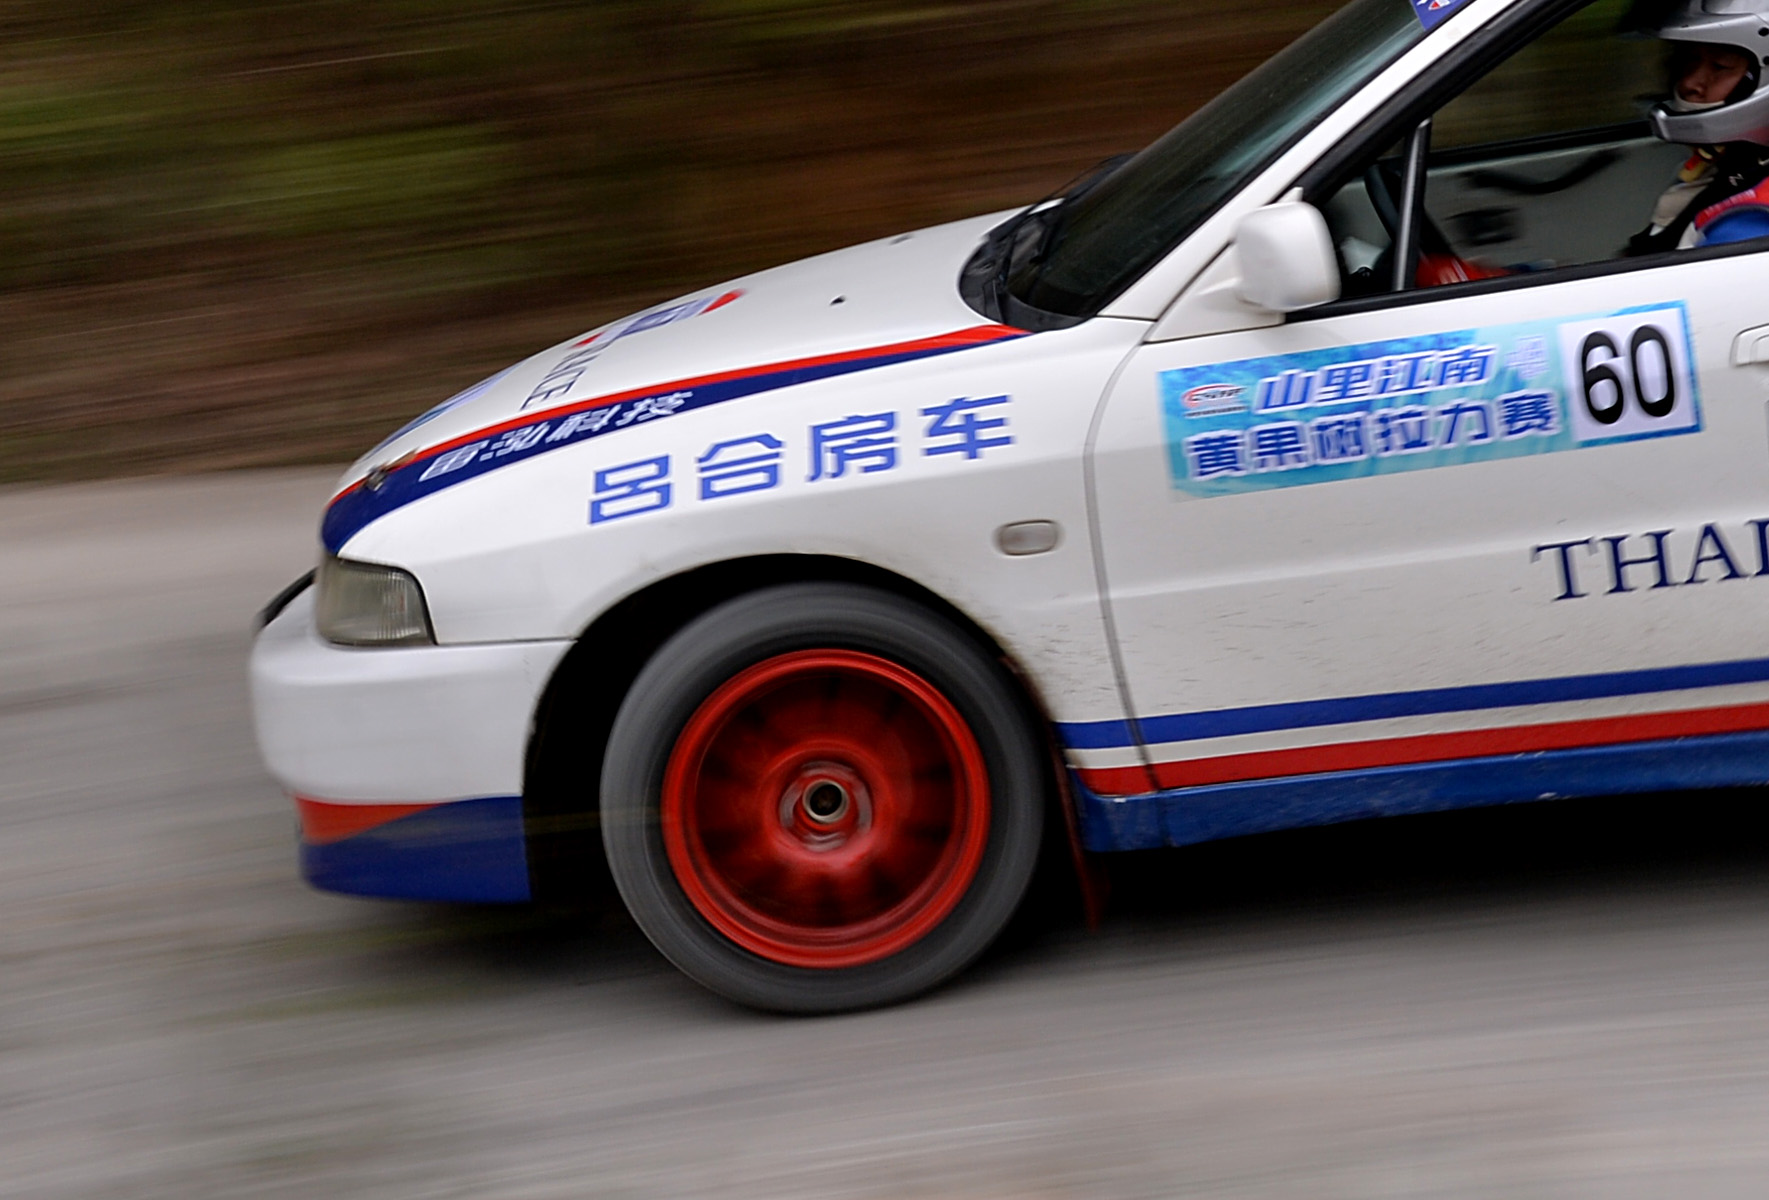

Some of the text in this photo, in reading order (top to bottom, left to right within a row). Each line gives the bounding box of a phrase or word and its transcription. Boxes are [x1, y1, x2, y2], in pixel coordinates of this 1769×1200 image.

[1254, 344, 1499, 414] 山里江南
[1581, 323, 1678, 425] 60
